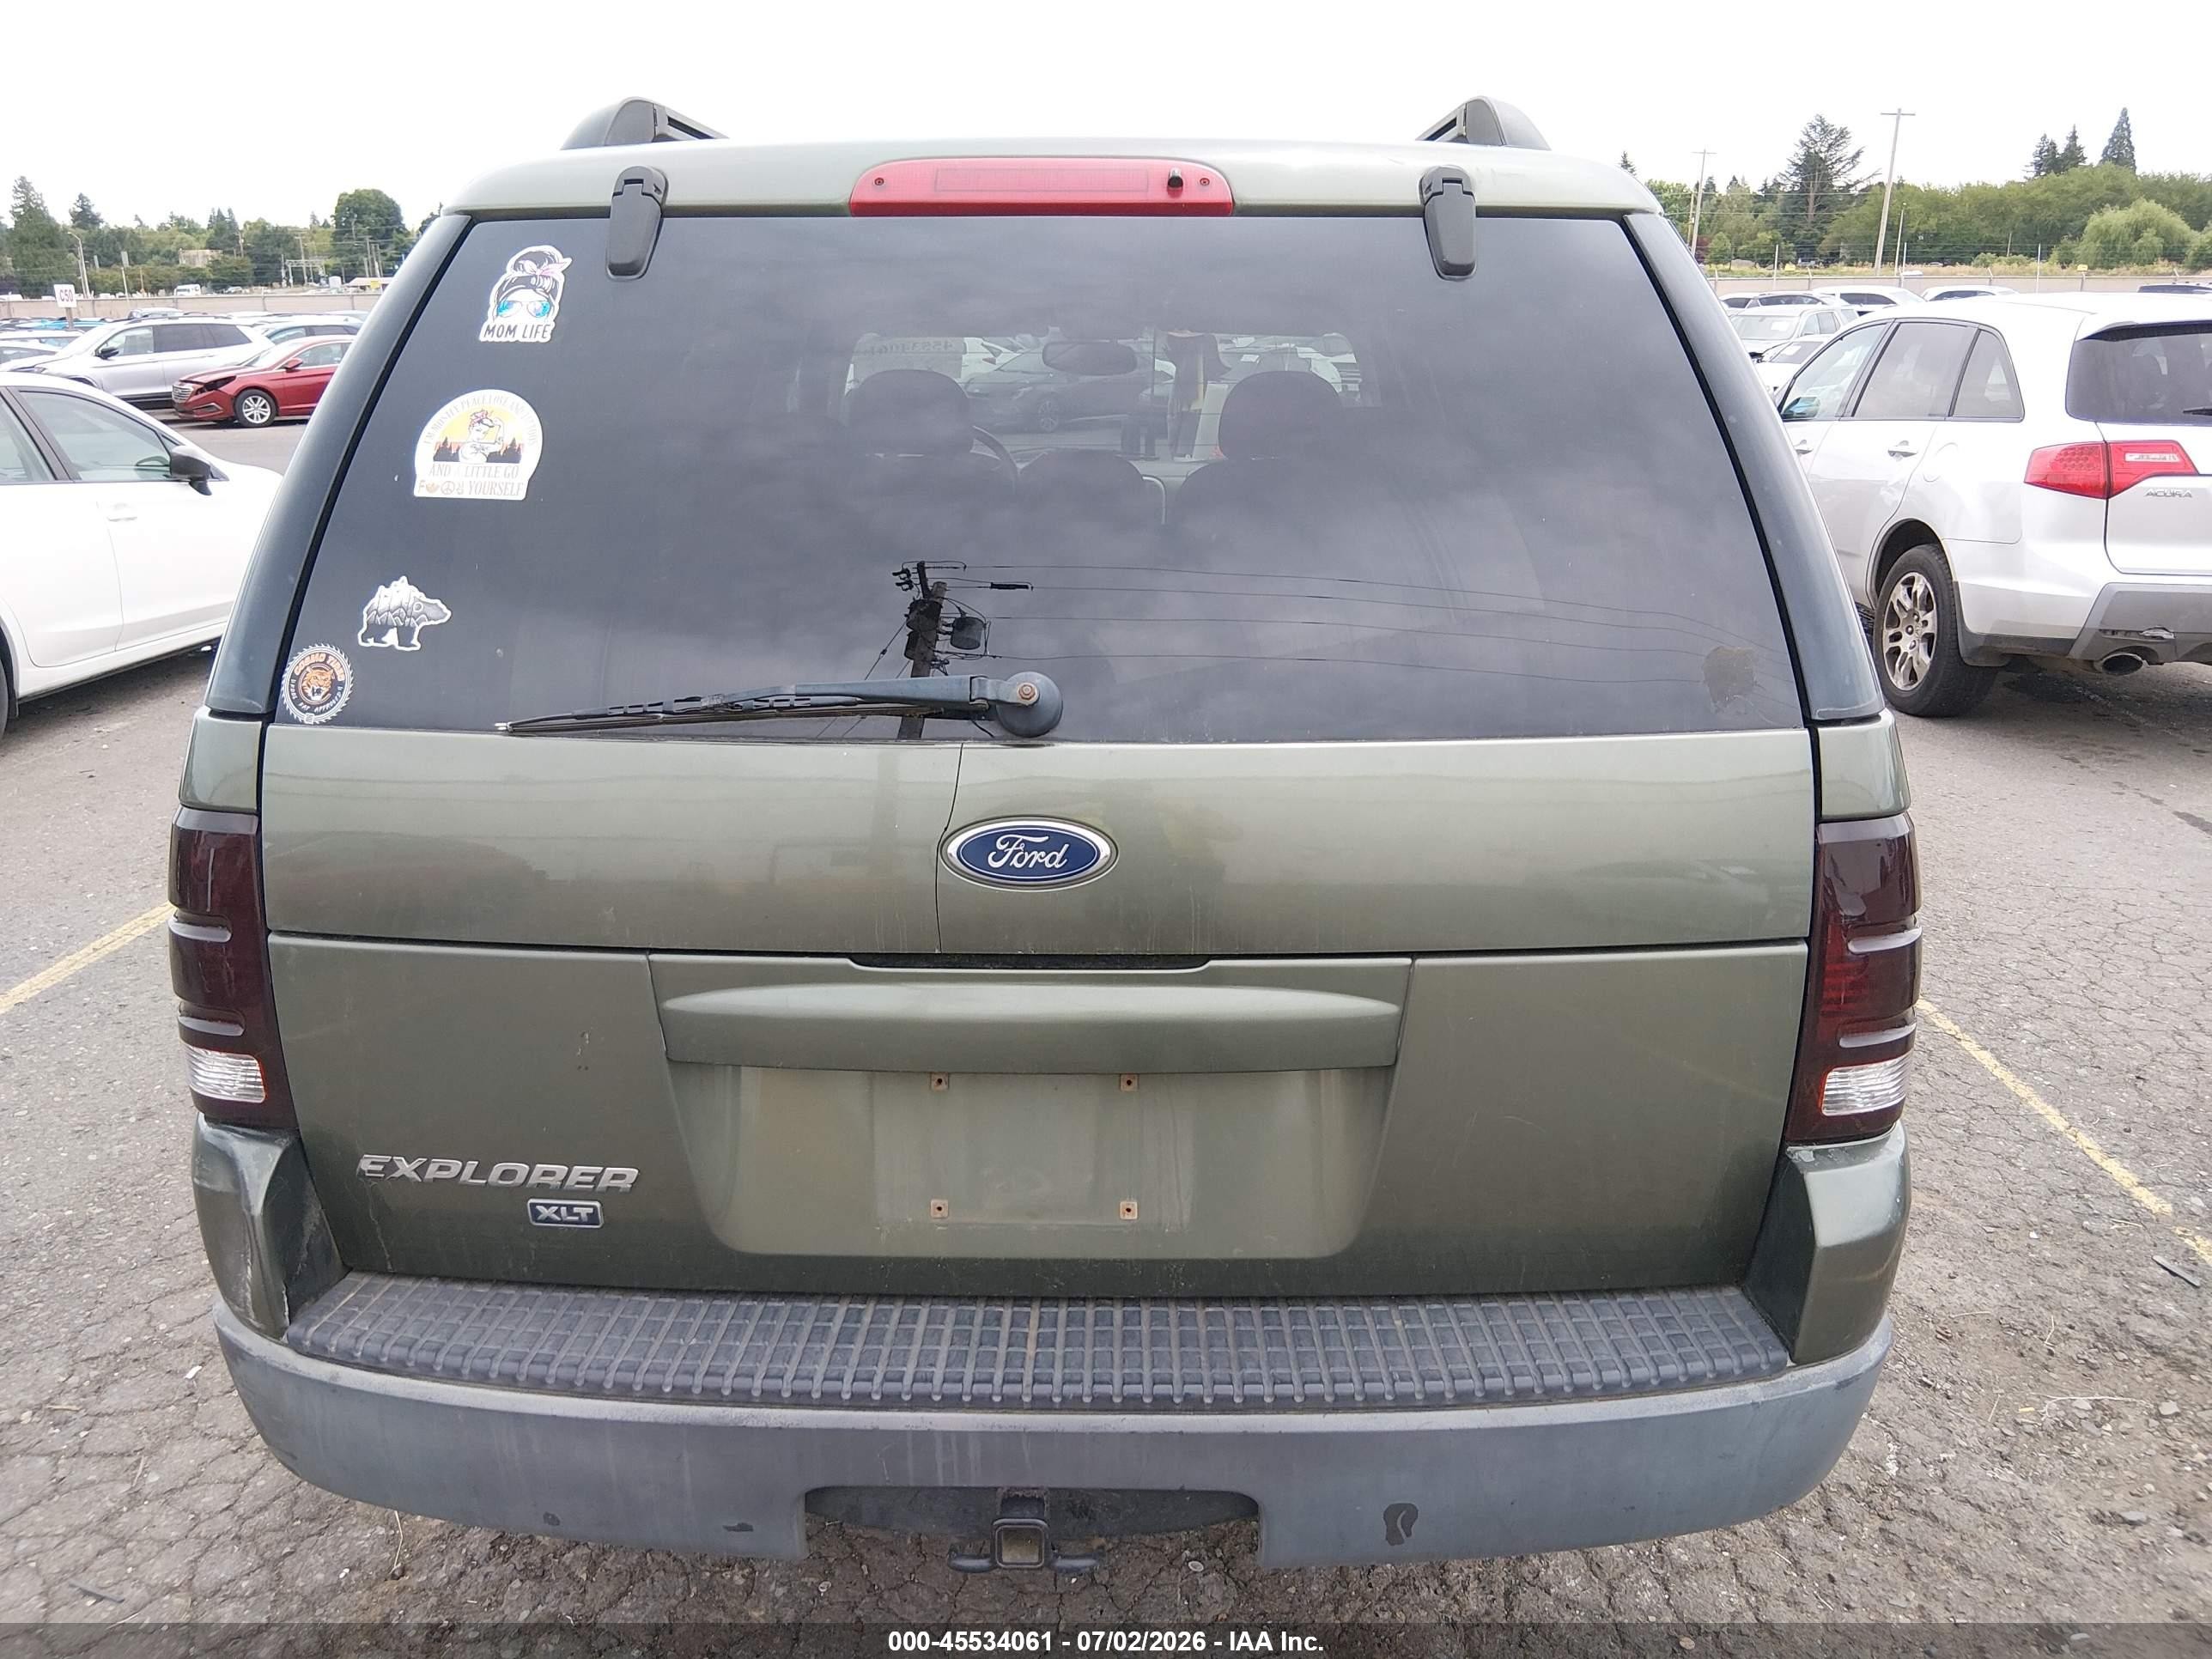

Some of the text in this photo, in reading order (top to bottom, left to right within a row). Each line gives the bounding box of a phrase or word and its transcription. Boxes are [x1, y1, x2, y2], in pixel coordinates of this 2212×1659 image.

[483, 324, 551, 339] MOM LIFE
[428, 464, 452, 477] AND
[465, 465, 501, 478] LITTLE
[503, 465, 520, 479] GO
[469, 480, 524, 496] YOURSELF
[2143, 487, 2193, 498] ACURA
[988, 833, 1070, 870] Ford
[356, 1153, 641, 1194] EXPLORER
[535, 1205, 594, 1224] XLT
